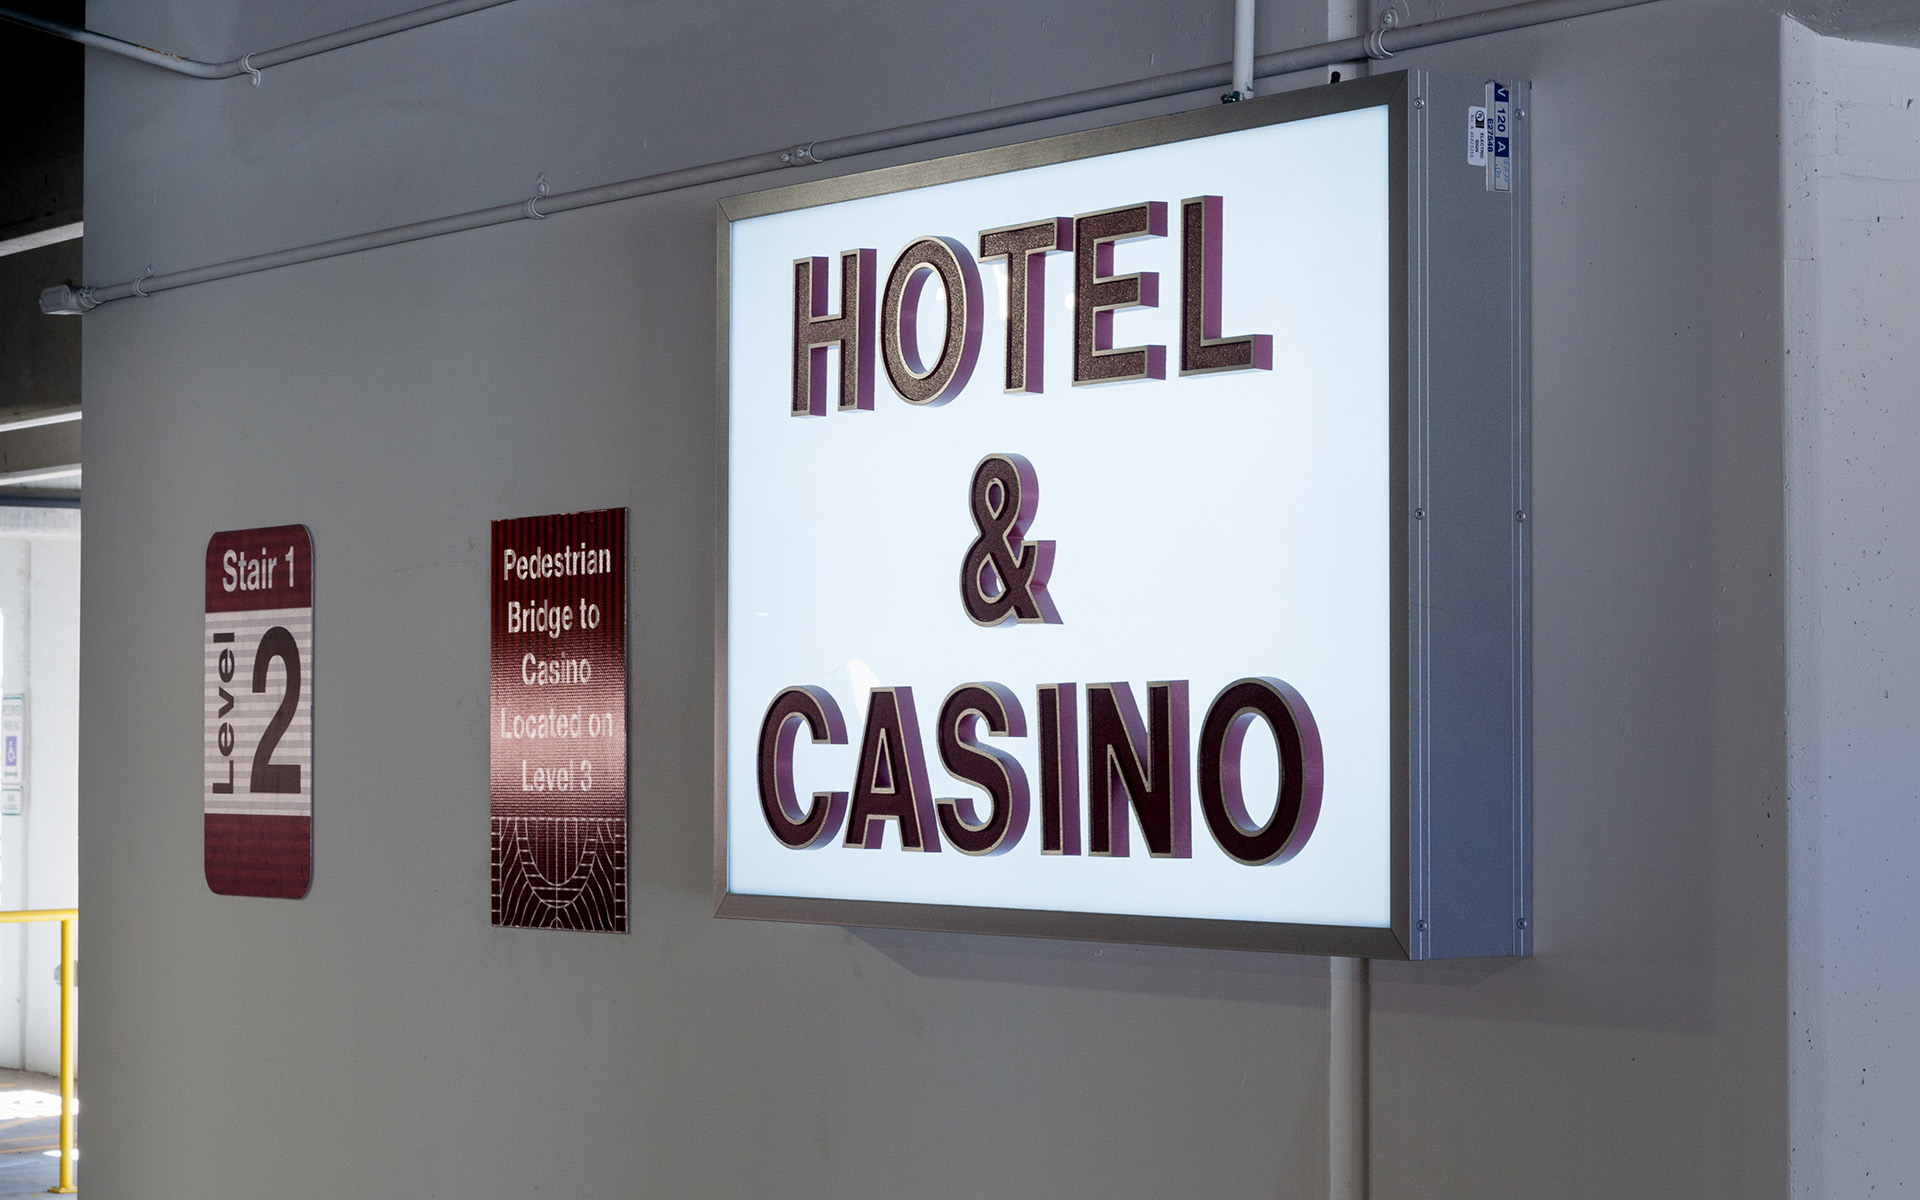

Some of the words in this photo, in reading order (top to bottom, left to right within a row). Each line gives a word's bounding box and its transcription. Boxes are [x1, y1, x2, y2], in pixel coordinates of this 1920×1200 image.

[1497, 88, 1506, 98] V
[1497, 108, 1506, 133] 120
[1497, 141, 1506, 153] A
[791, 195, 1273, 417] HOTEL
[959, 453, 1064, 627] &
[222, 548, 278, 593] Stair
[285, 546, 295, 587] 1
[503, 542, 611, 581] Pedestrian
[508, 599, 573, 638] Bridge
[580, 598, 600, 630] to
[522, 651, 591, 686] Casino
[212, 632, 235, 794] Level
[250, 626, 301, 794] 2
[500, 706, 582, 740] Located
[588, 711, 613, 738] on
[521, 759, 574, 792] Level
[580, 759, 592, 791] 3
[756, 676, 1324, 867] CASINO
